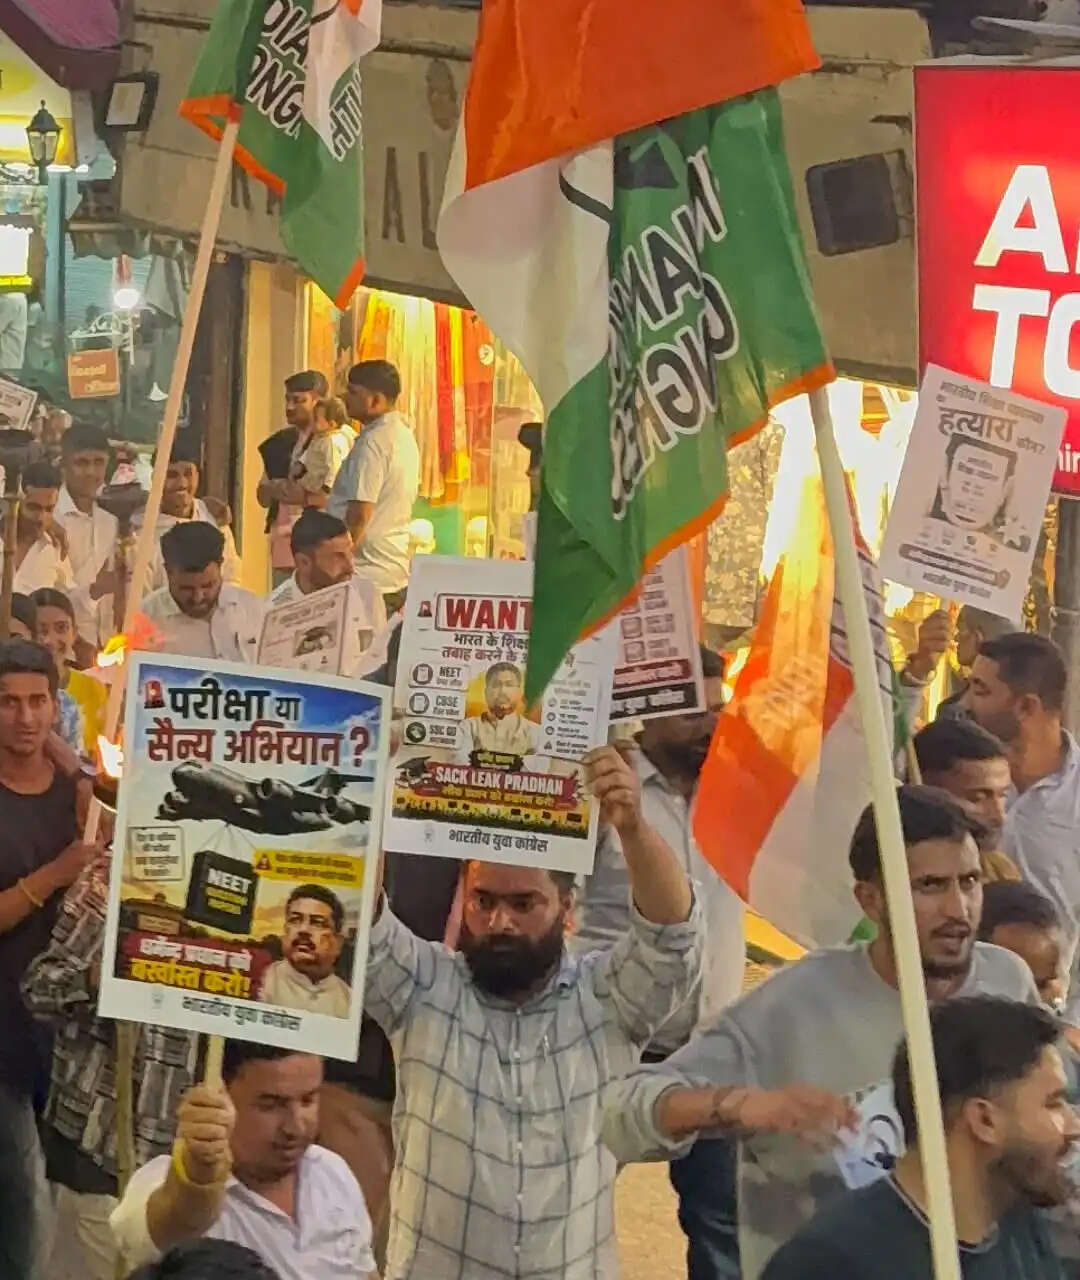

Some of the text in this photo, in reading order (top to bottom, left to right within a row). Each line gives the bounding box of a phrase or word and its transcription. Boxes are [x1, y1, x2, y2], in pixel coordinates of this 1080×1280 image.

[937, 406, 1018, 443] हत्यारा
[445, 598, 533, 631] WANT
[454, 632, 483, 646] भारत
[486, 631, 499, 647] के
[475, 646, 503, 662] करने
[168, 676, 304, 721] परीक्षा या
[145, 716, 371, 768] सैन्य अभियान ?
[435, 766, 564, 796] SACK LEAK PRADHAN
[449, 827, 548, 853] भारतीय युवा कांग्रेस
[208, 868, 252, 894] NEET
